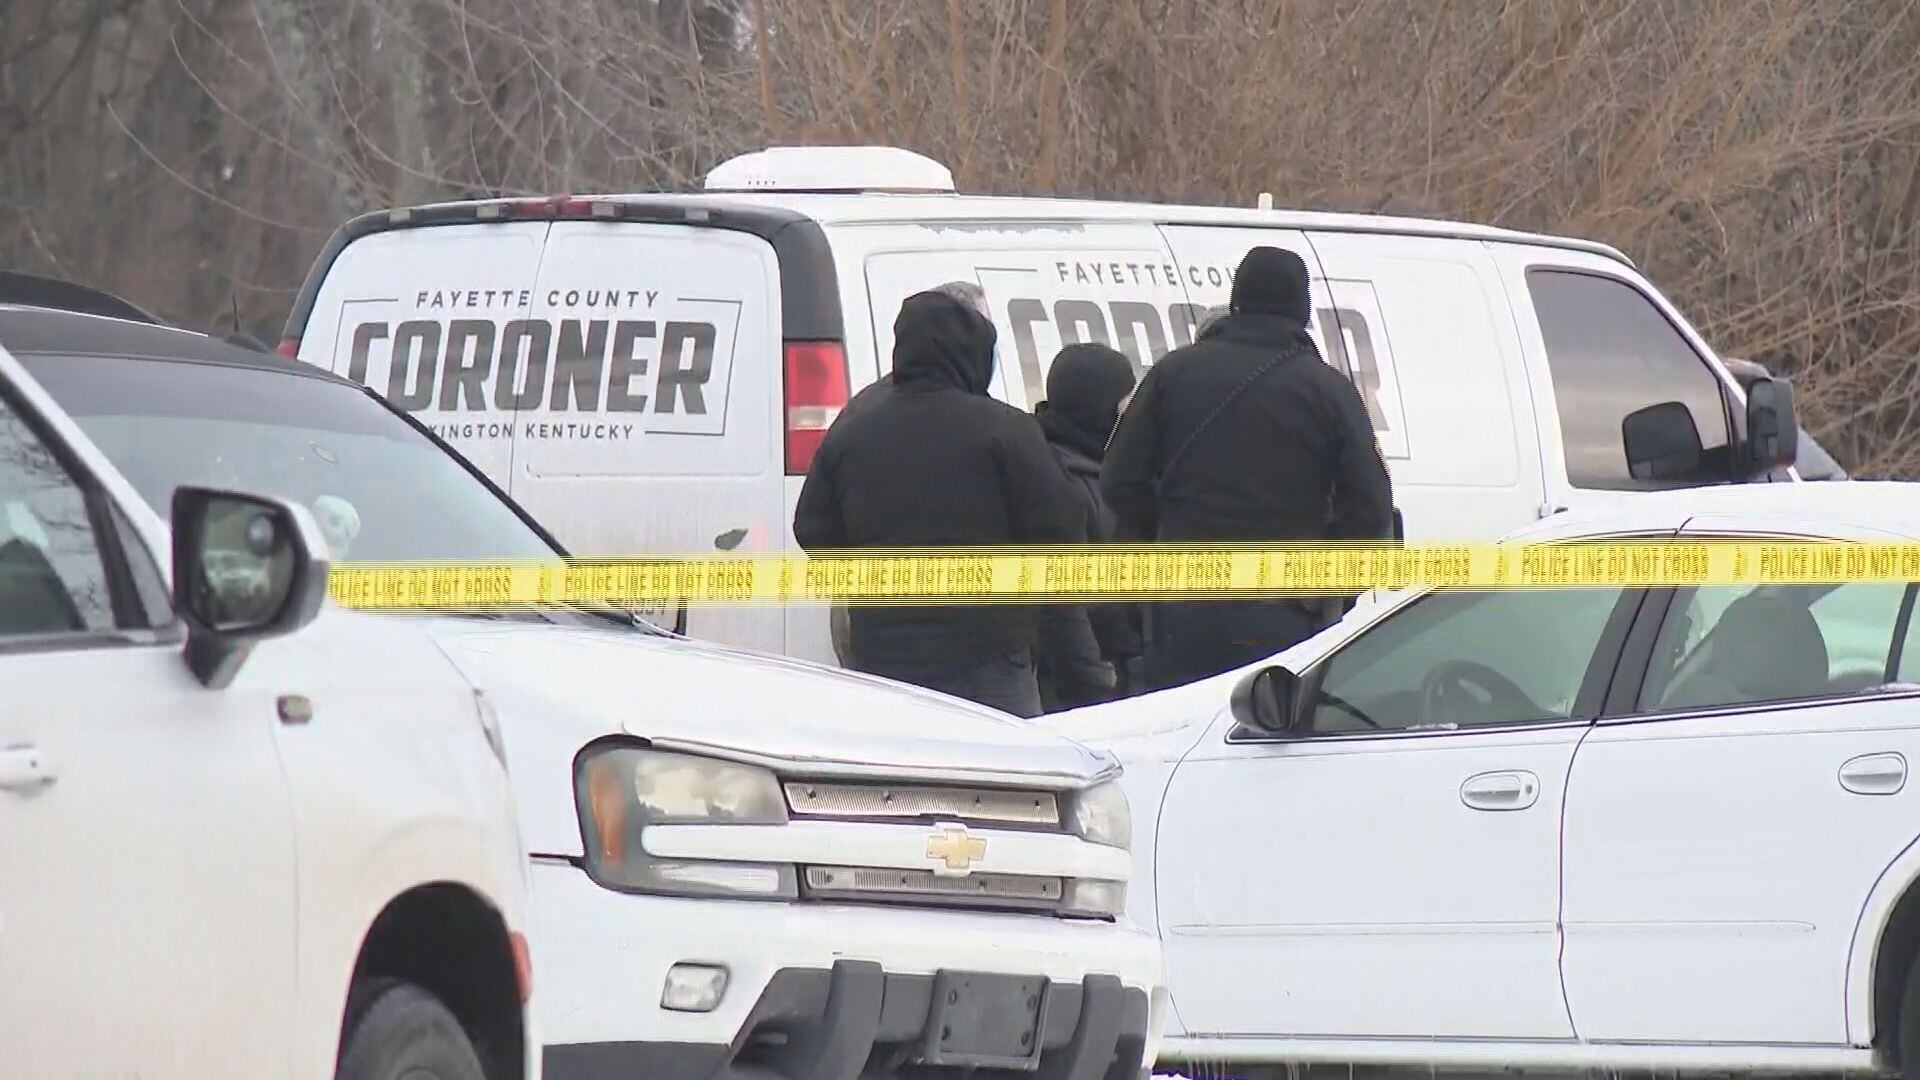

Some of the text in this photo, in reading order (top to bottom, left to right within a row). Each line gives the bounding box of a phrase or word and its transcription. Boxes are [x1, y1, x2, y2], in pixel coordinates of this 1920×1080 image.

[1056, 262, 1176, 288] FAYETTE
[415, 289, 660, 308] FAYETTE COUNTY
[348, 318, 717, 415] CORONER
[428, 422, 634, 440] XINGTON KENTUCKY
[565, 560, 754, 604] POLICE LINE DO NOT CROSS
[805, 555, 993, 598] POLICE LINE DO NOT CROSS
[1045, 551, 1233, 594] POLICE LINE DO NOT CROSS
[1284, 547, 1471, 588] POLICE LINE DO NOT CROSS
[1521, 546, 1709, 585] POLICE LINE DO NOT CROSS
[1760, 547, 1807, 580] POLICE
[1811, 546, 1843, 579] LINE
[1846, 546, 1866, 578] DO
[1870, 545, 1898, 577] NOT
[329, 566, 512, 608] OLICE LINE DO NOT CROSS
